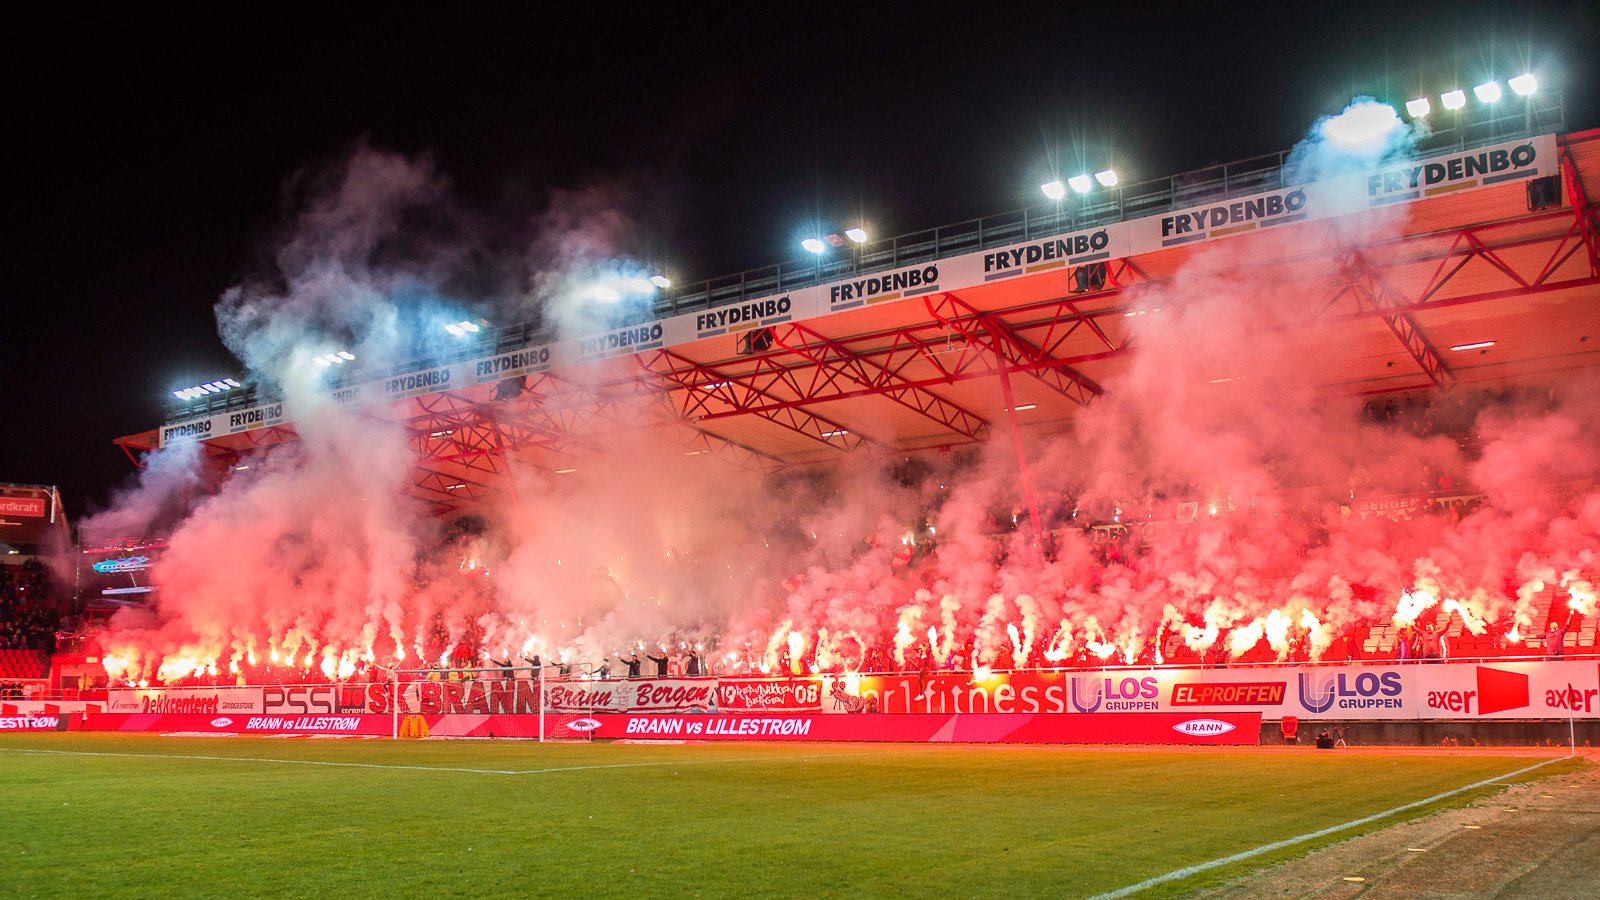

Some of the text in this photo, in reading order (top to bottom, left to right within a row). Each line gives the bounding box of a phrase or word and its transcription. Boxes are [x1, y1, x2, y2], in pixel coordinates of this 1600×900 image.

[1368, 141, 1536, 197] FRYDENBØ
[1162, 188, 1306, 238] FRYDENBØ
[984, 228, 1109, 272] FRYDENBØ
[831, 264, 939, 303] FRYDENBØ
[697, 295, 791, 331] FRYDENBØ
[579, 322, 663, 355] FRYDENBØ
[476, 347, 550, 376] FRYDENBØ
[385, 367, 450, 394] FRYDENBØ
[230, 403, 283, 427] FRYDENBØ
[164, 419, 212, 441] FRYDENBØ
[551, 683, 710, 708] Brann Bergen
[1105, 677, 1159, 699] LOS
[1176, 685, 1282, 703] EL-PROFFEN
[1338, 671, 1403, 697] LOS
[263, 687, 332, 714] PSS
[368, 680, 540, 714] SK BRANN
[1106, 701, 1159, 711] GRUPPEN
[1339, 698, 1403, 709] GRUPPEN
[1428, 690, 1476, 714] axer
[1546, 688, 1598, 713] axer
[247, 717, 361, 730] BRANN vs LILLESTRØM
[626, 718, 811, 735] BRANN vs LILLESTRØM
[1185, 723, 1223, 732] BRANN
